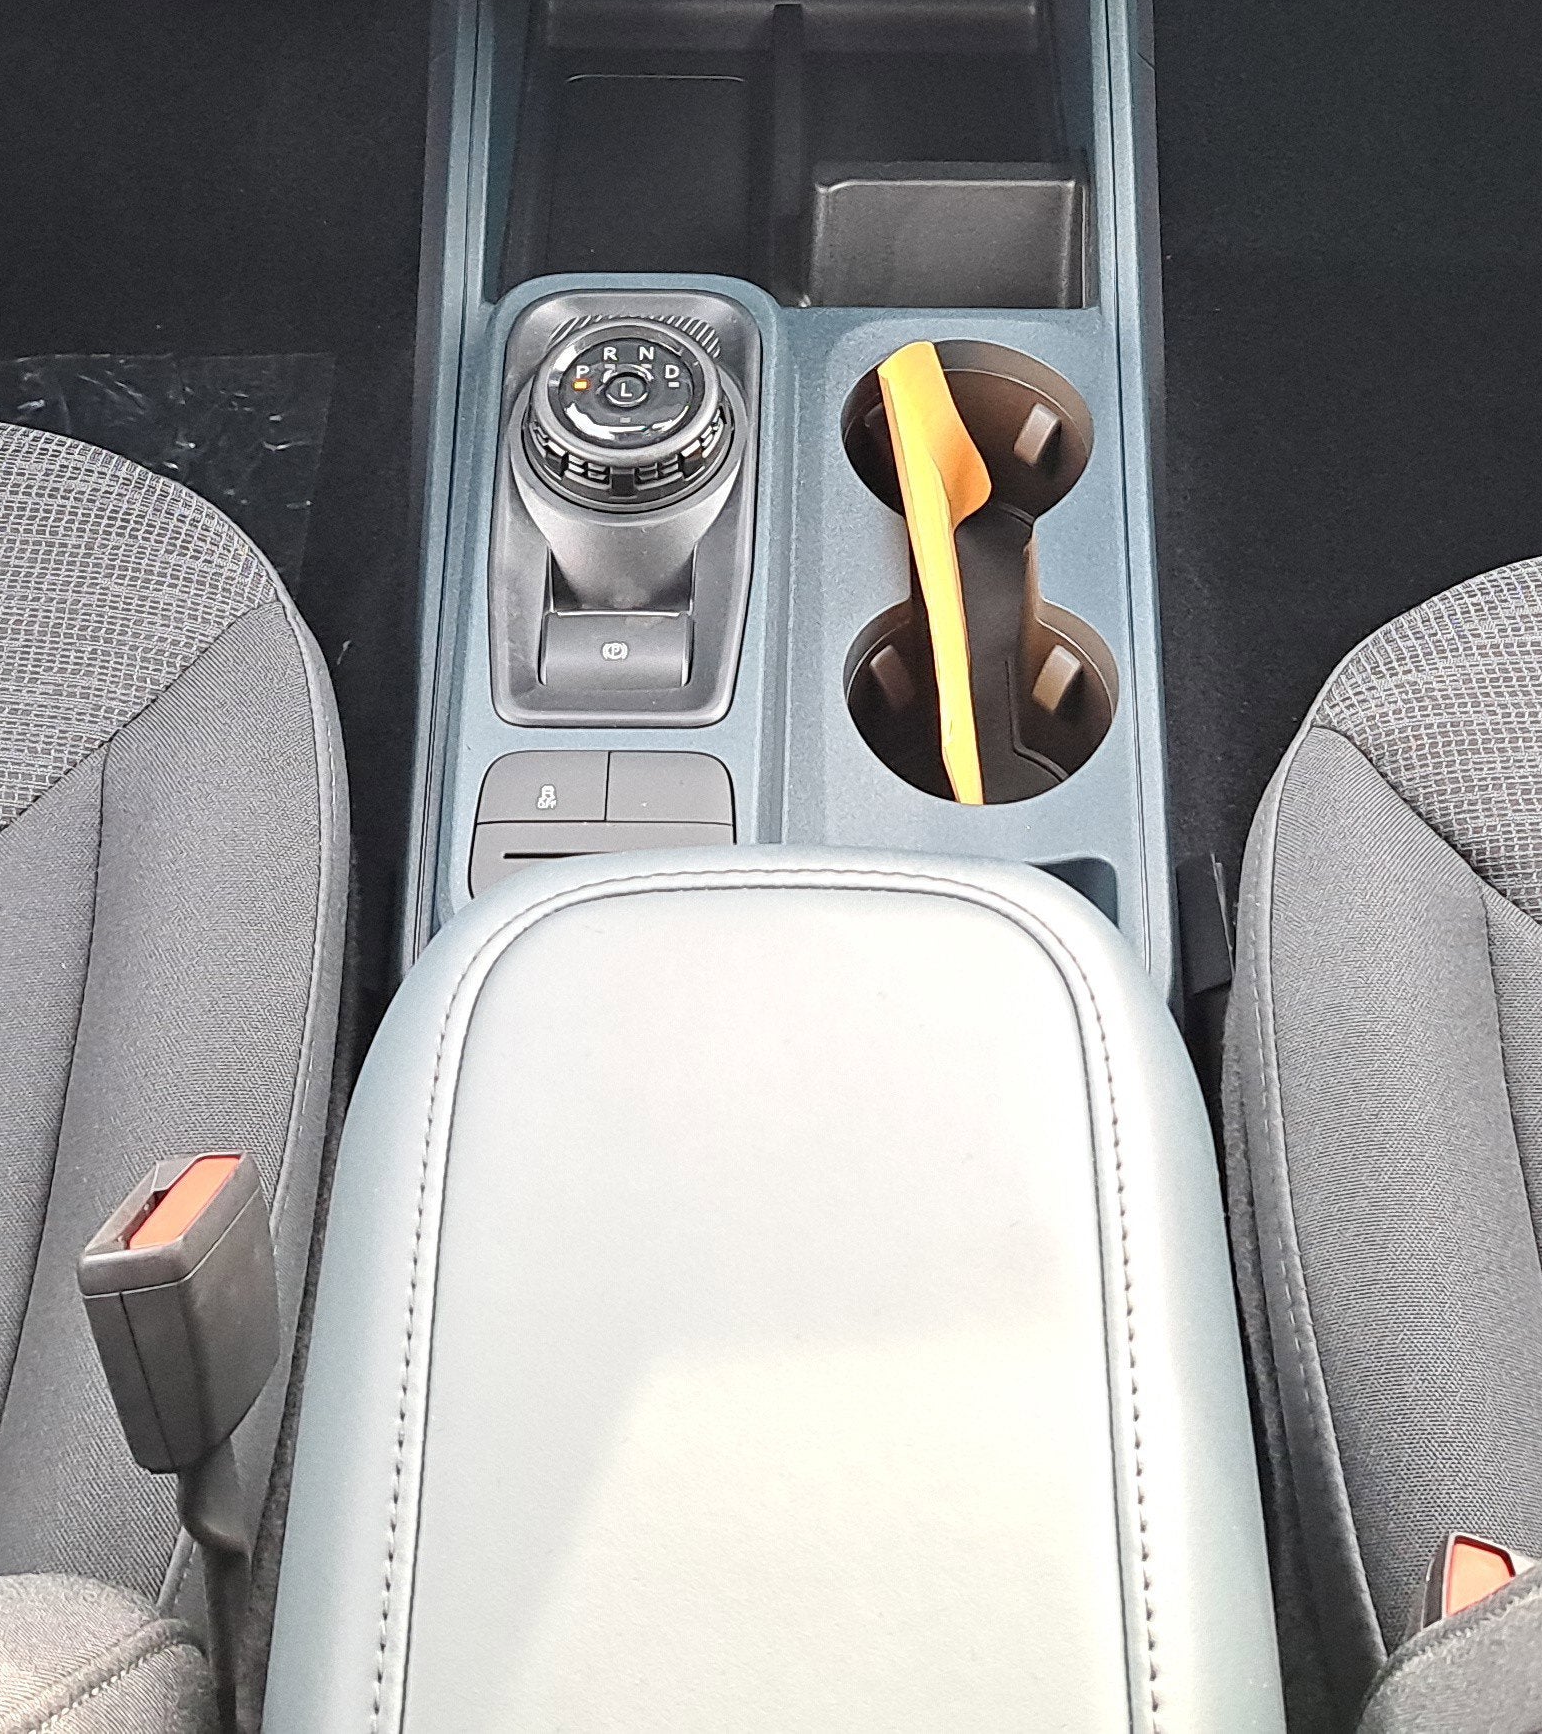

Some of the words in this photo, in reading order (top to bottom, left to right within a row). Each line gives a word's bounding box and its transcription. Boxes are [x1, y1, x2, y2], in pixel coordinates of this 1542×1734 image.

[603, 346, 618, 361] R
[638, 346, 655, 361] N
[575, 365, 590, 379] P
[665, 364, 680, 379] D
[620, 382, 633, 398] L
